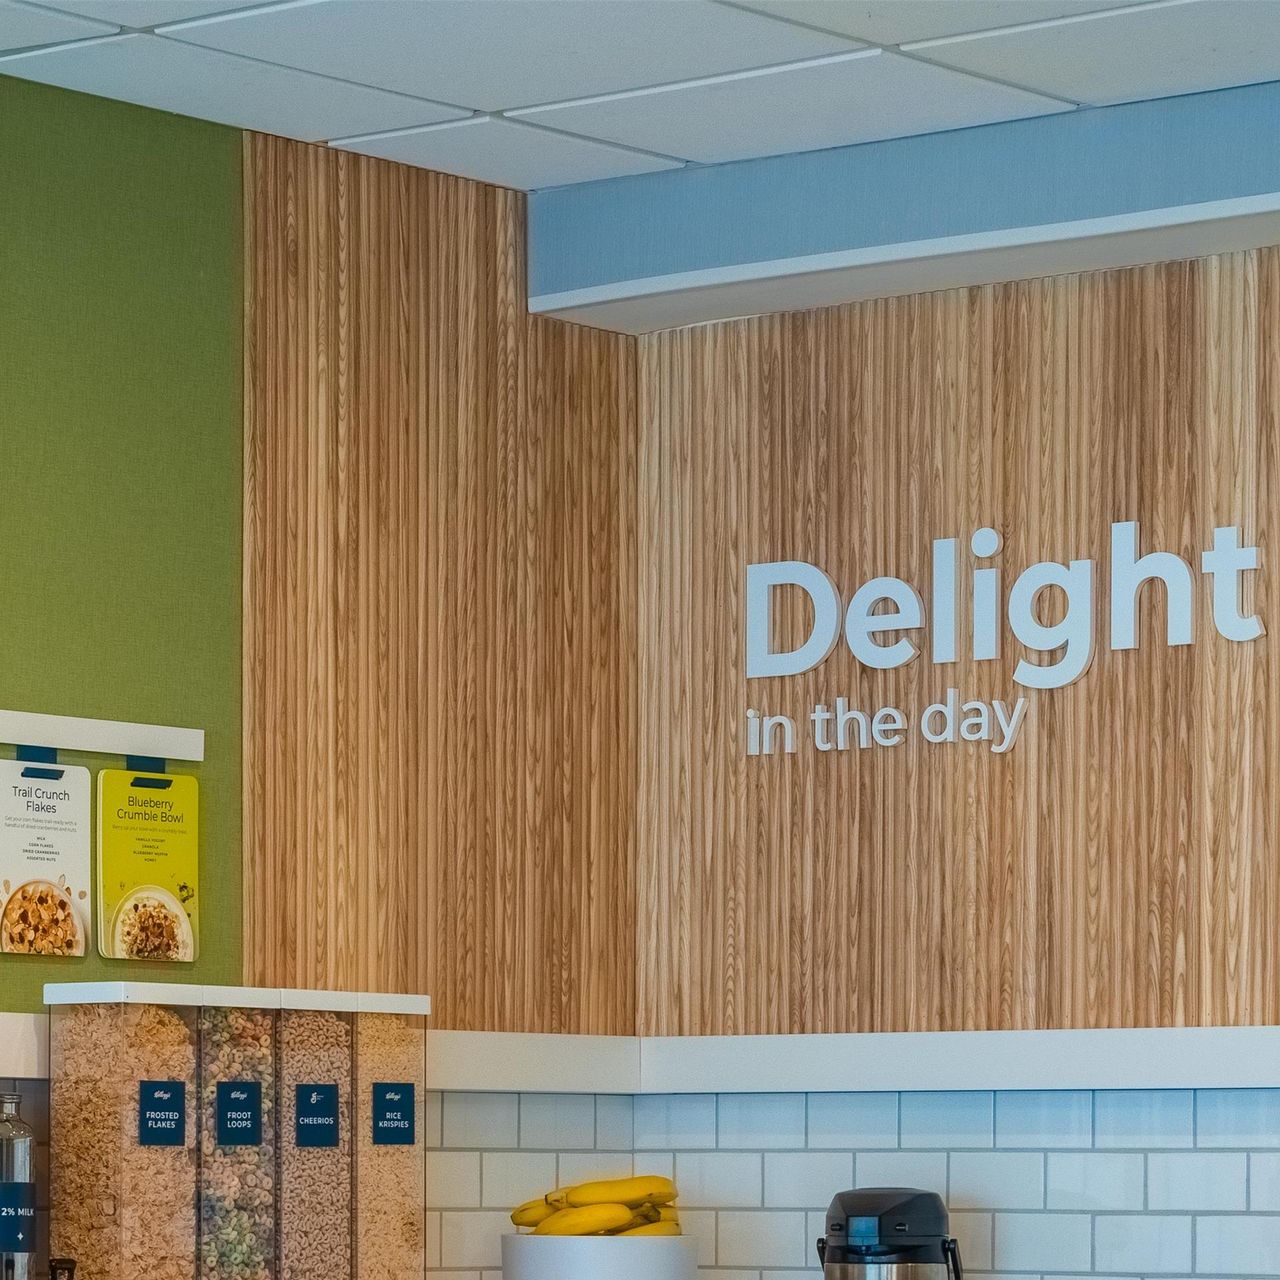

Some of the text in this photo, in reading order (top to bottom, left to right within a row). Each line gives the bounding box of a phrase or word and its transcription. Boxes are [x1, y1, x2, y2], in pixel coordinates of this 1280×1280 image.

[747, 520, 1267, 689] Delight
[747, 688, 1029, 756] in the day
[12, 786, 70, 801] Trail Crunch
[26, 801, 57, 813] Flakes
[128, 796, 174, 811] Blueberry
[117, 808, 184, 823] Crumble Bowl
[146, 1111, 179, 1119] FROSTED
[227, 1111, 252, 1119] FROOT
[148, 1120, 176, 1128] FLAKES
[227, 1120, 252, 1128] LOOPS
[299, 1117, 334, 1125] CHEERIOS
[378, 1120, 409, 1128] KRISPIES
[1, 1207, 35, 1216] 2% MILK
